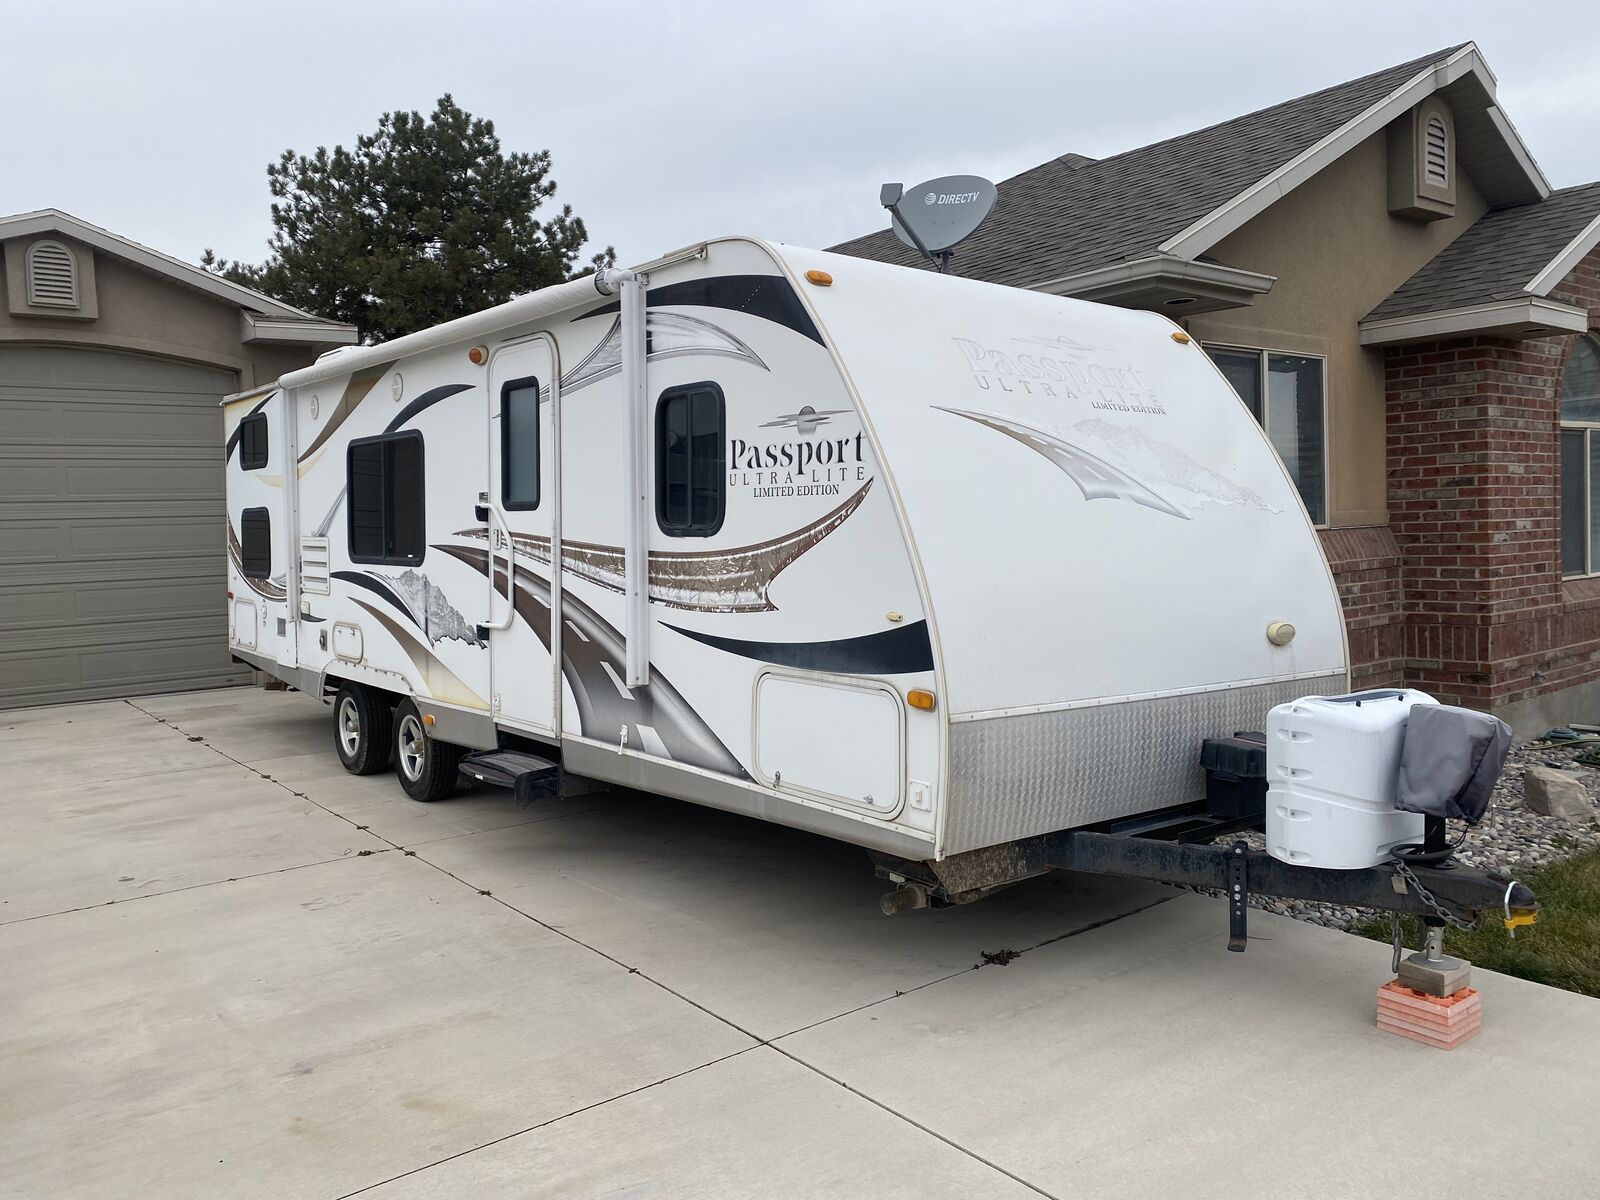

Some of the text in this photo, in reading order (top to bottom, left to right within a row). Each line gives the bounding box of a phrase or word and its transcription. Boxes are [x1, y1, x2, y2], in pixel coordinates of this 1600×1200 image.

[938, 191, 980, 204] DIRECTV
[950, 336, 1153, 393] Passport
[974, 374, 1163, 408] ULTRA LITE
[1090, 401, 1167, 415] LIMITED EDITION
[730, 430, 866, 476] Passport
[729, 466, 865, 486] ULTRA LITE
[753, 483, 840, 498] LIMITED EDITION
